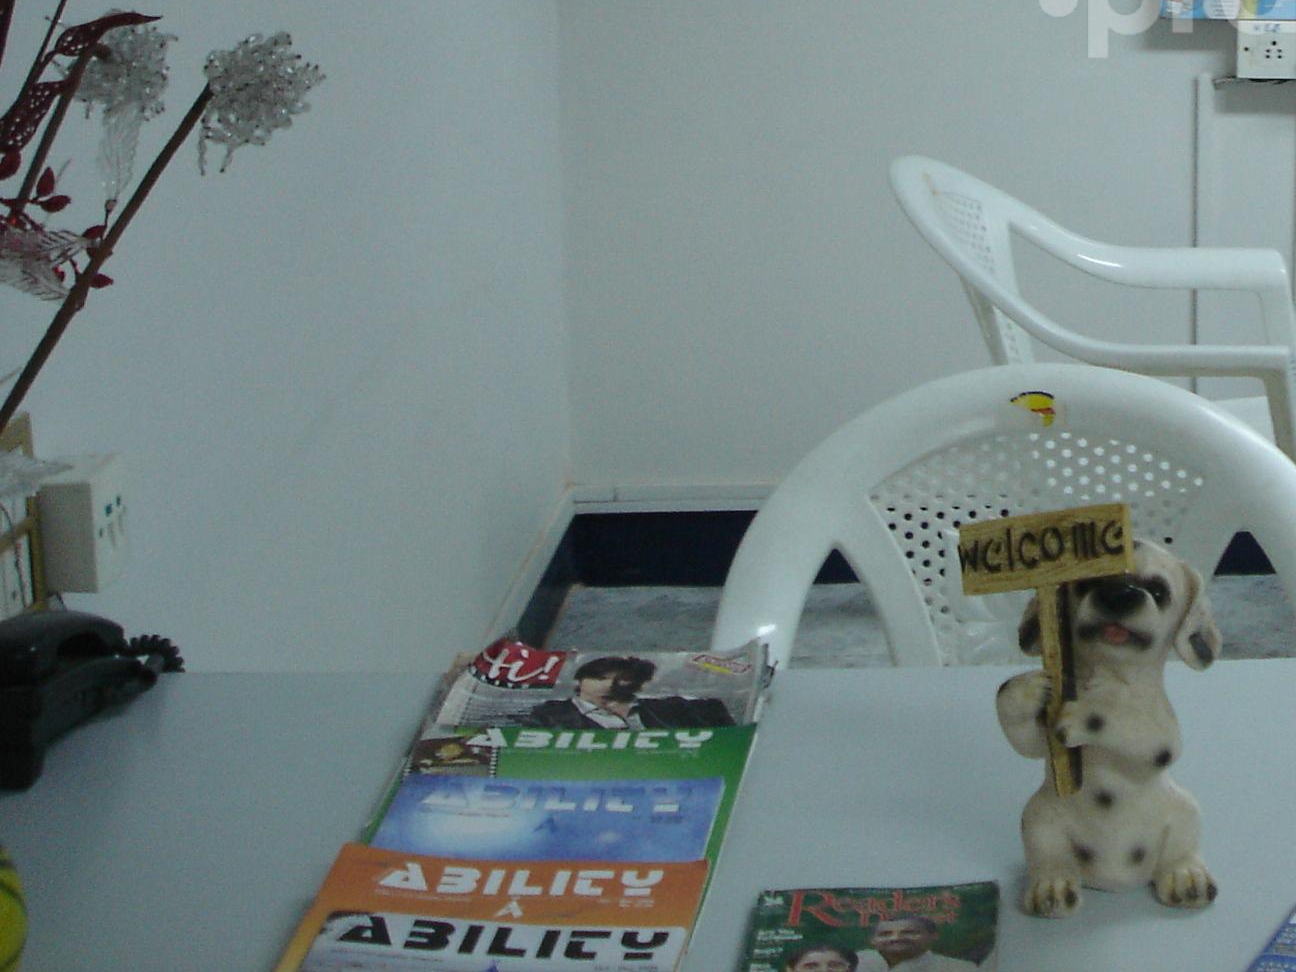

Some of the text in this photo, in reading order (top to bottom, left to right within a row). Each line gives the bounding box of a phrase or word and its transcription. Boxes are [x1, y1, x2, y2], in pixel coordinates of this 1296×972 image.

[465, 727, 714, 751] ABILITY
[378, 862, 664, 897] ABILITY
[336, 916, 670, 960] ABILITY
